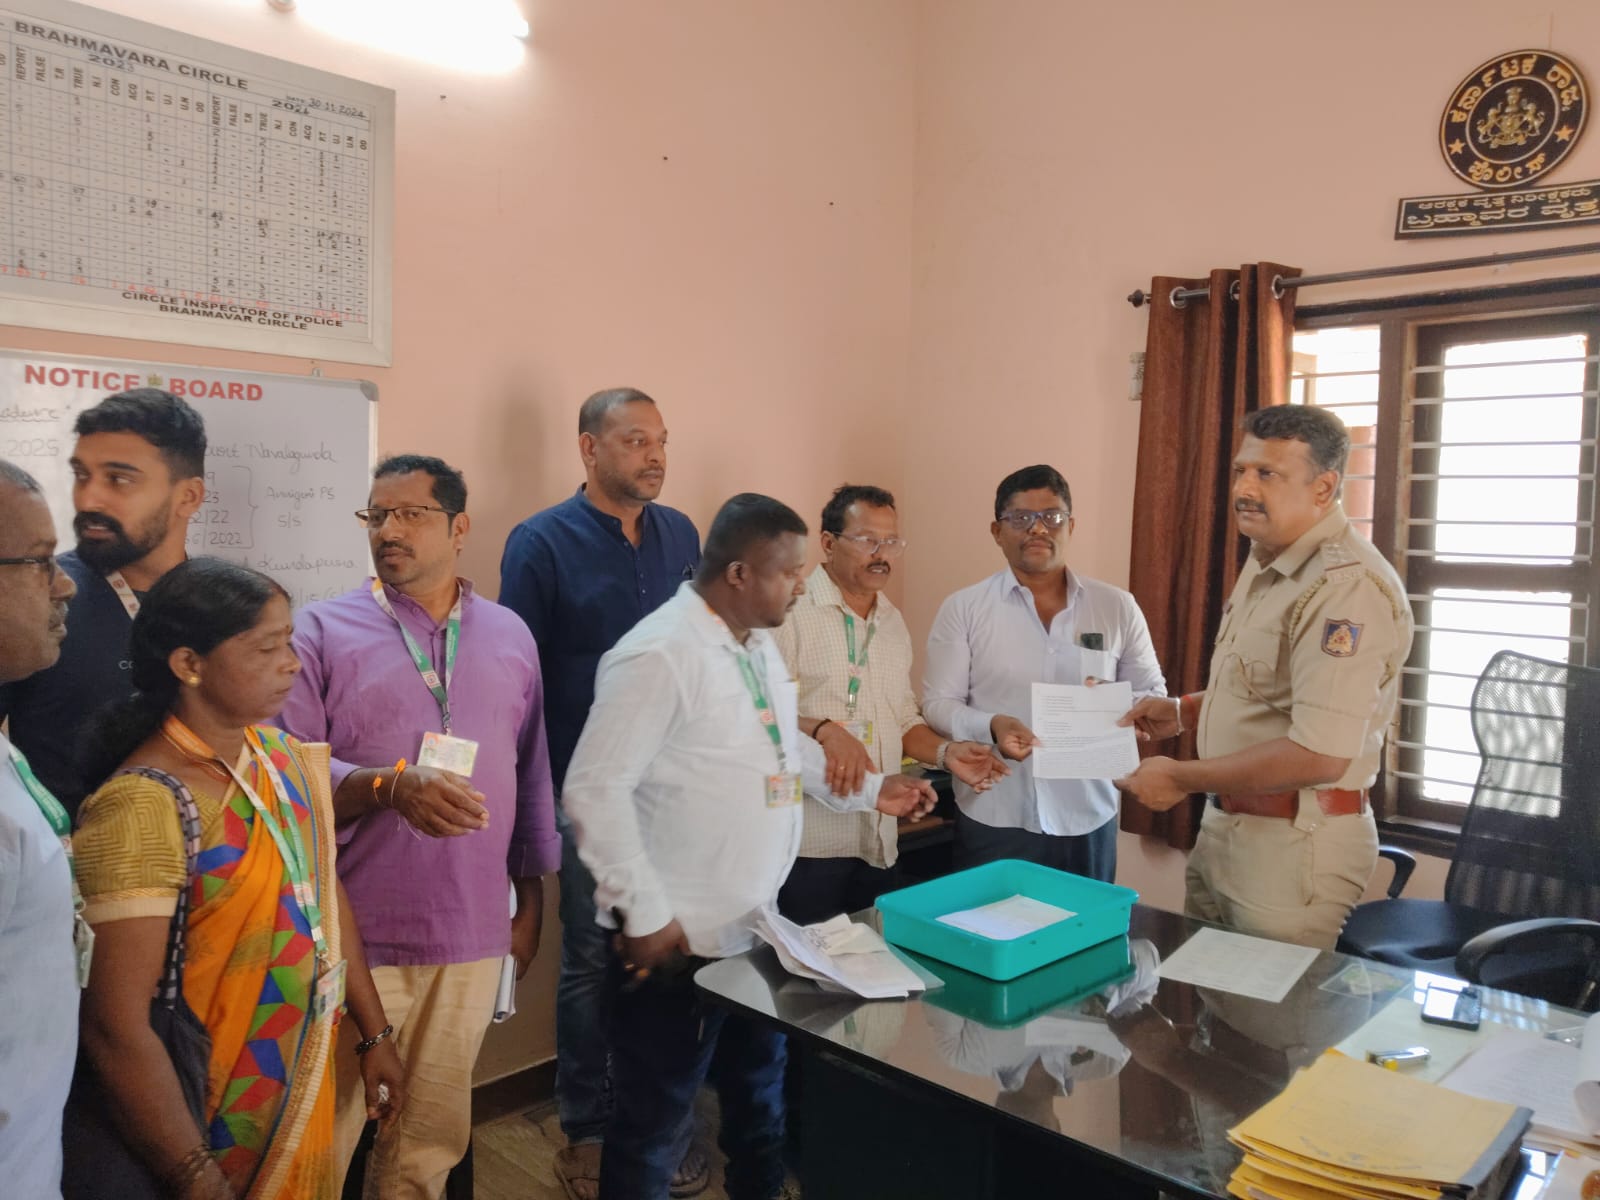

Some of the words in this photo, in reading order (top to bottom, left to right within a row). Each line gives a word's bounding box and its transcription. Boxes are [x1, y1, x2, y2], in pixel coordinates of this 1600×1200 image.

[15, 21, 170, 70] BRAHMAVARA
[178, 64, 249, 90] CIRCLE
[15, 46, 26, 81] REPORT
[35, 56, 46, 82] FALSE
[73, 66, 84, 89] TRUE
[211, 95, 221, 127] REPORT
[228, 103, 238, 127] FALSE
[122, 292, 178, 304] CIRCLE
[184, 299, 268, 317] INSPECTOR
[272, 311, 290, 321] OF
[295, 314, 344, 328] POLICE
[159, 304, 254, 323] BRAHMAVAR
[257, 317, 308, 330] CIRCLE
[24, 364, 140, 392] NOTICE
[169, 377, 263, 401] BOARD
